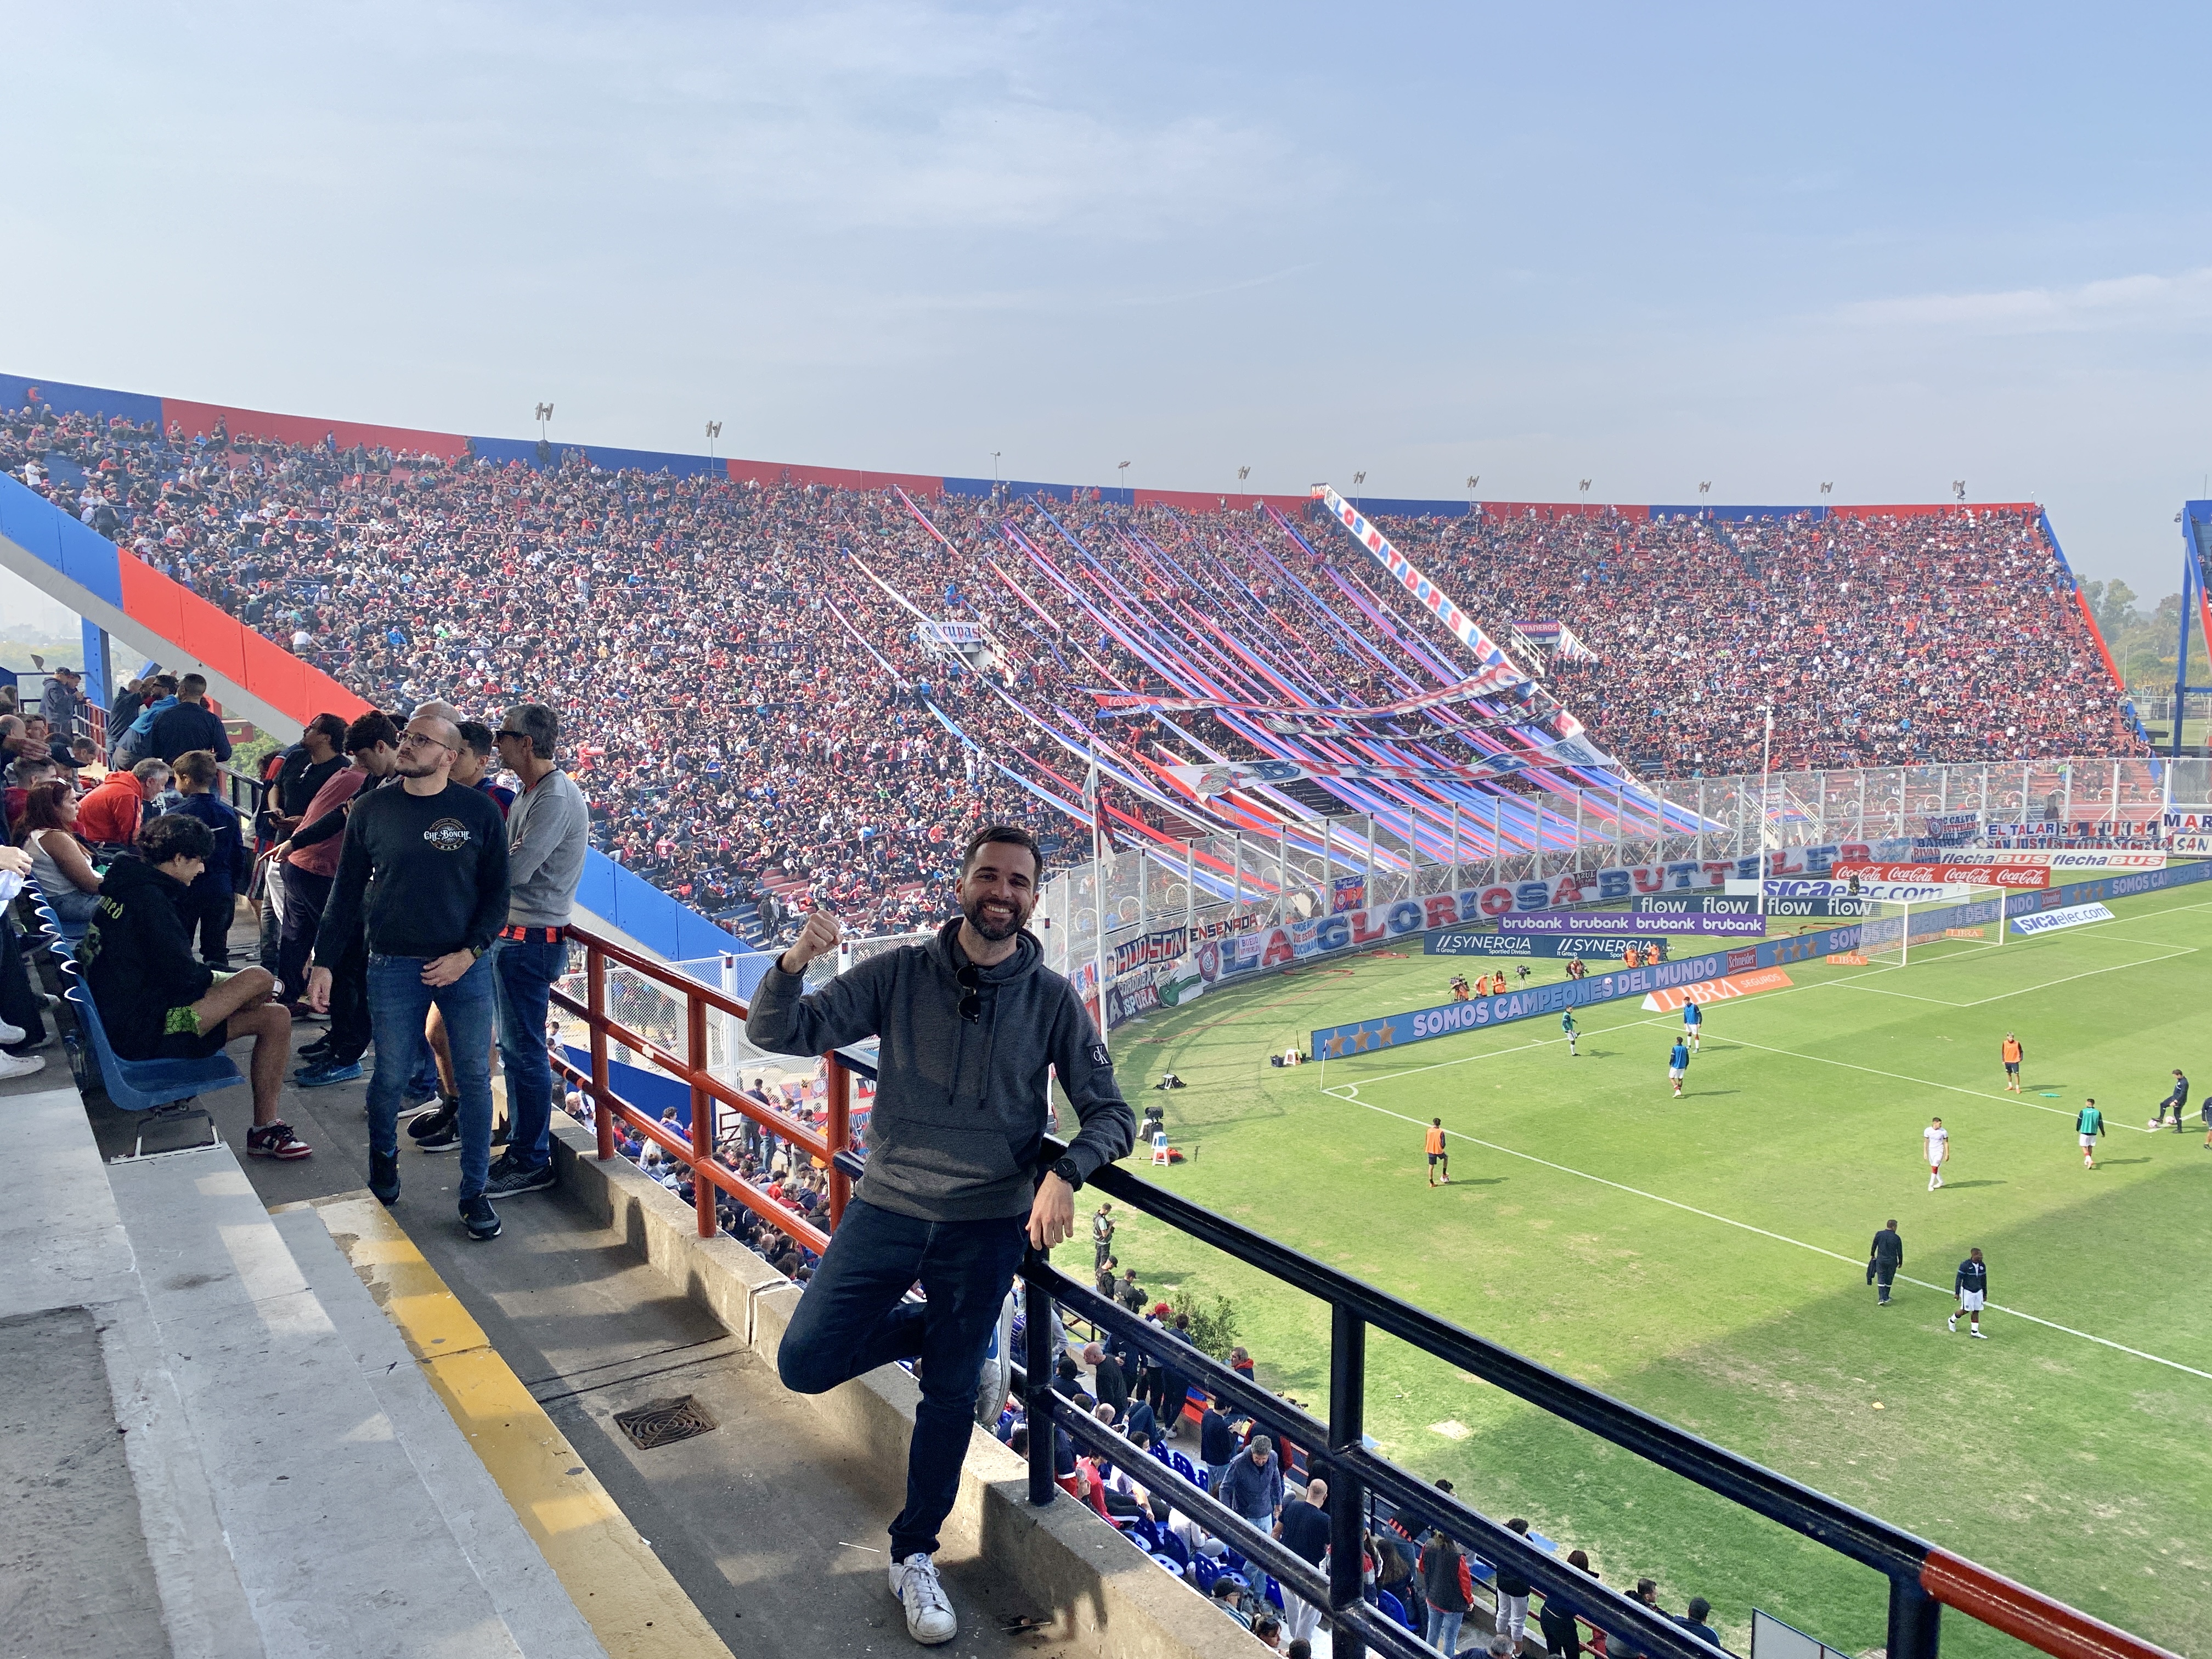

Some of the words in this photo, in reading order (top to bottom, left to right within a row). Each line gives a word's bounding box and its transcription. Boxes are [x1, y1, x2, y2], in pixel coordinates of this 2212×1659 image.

[1333, 498, 1364, 534] LOS
[1368, 532, 1462, 633] MATADORES
[1467, 628, 1492, 662] DE
[1950, 814, 1976, 824] CALVO
[1988, 825, 2006, 836] EL
[2010, 823, 2054, 836] TALAR
[2058, 822, 2081, 837] EL
[2092, 822, 2155, 837] TUNEL
[1916, 839, 1962, 848] BARRIO
[1995, 839, 2011, 849] AN
[2177, 837, 2209, 852] SAN
[1836, 866, 1884, 881] Coc-Cola
[1888, 867, 1936, 882] Coca-Cola
[1944, 867, 1994, 883] Coca-Cola
[1997, 868, 2046, 884] Coca-Cola
[1759, 881, 1943, 902] sicaeec.com
[2113, 875, 2149, 895] SOMOS
[1316, 877, 1582, 950] GLORIOSA
[1598, 844, 1871, 898] BUTTELER
[1641, 899, 1687, 913] flow
[1702, 899, 1749, 915] flow
[1767, 899, 1812, 915] flow
[1827, 899, 1872, 915] flow
[1190, 912, 1257, 942] ENSENADA
[1503, 917, 1562, 929] brubank
[1570, 916, 1628, 929] brubank
[1636, 917, 1695, 930] brubank
[1703, 918, 1762, 931] brubank
[2020, 906, 2110, 931] sicaelec.com
[1116, 929, 1186, 975] HUDSON
[1453, 936, 1531, 950] SYNERGIA
[1573, 939, 1651, 952] SYNERGIA
[1413, 1002, 1489, 1038] SOMOS
[1494, 977, 1613, 1020] CAMPEONES
[1618, 968, 1652, 995] DEL
[1655, 957, 1717, 988] MUNDO
[1728, 952, 1756, 969] Schneider
[1658, 978, 1745, 1010] LIBRA
[1740, 973, 1782, 988] SEGUROS
